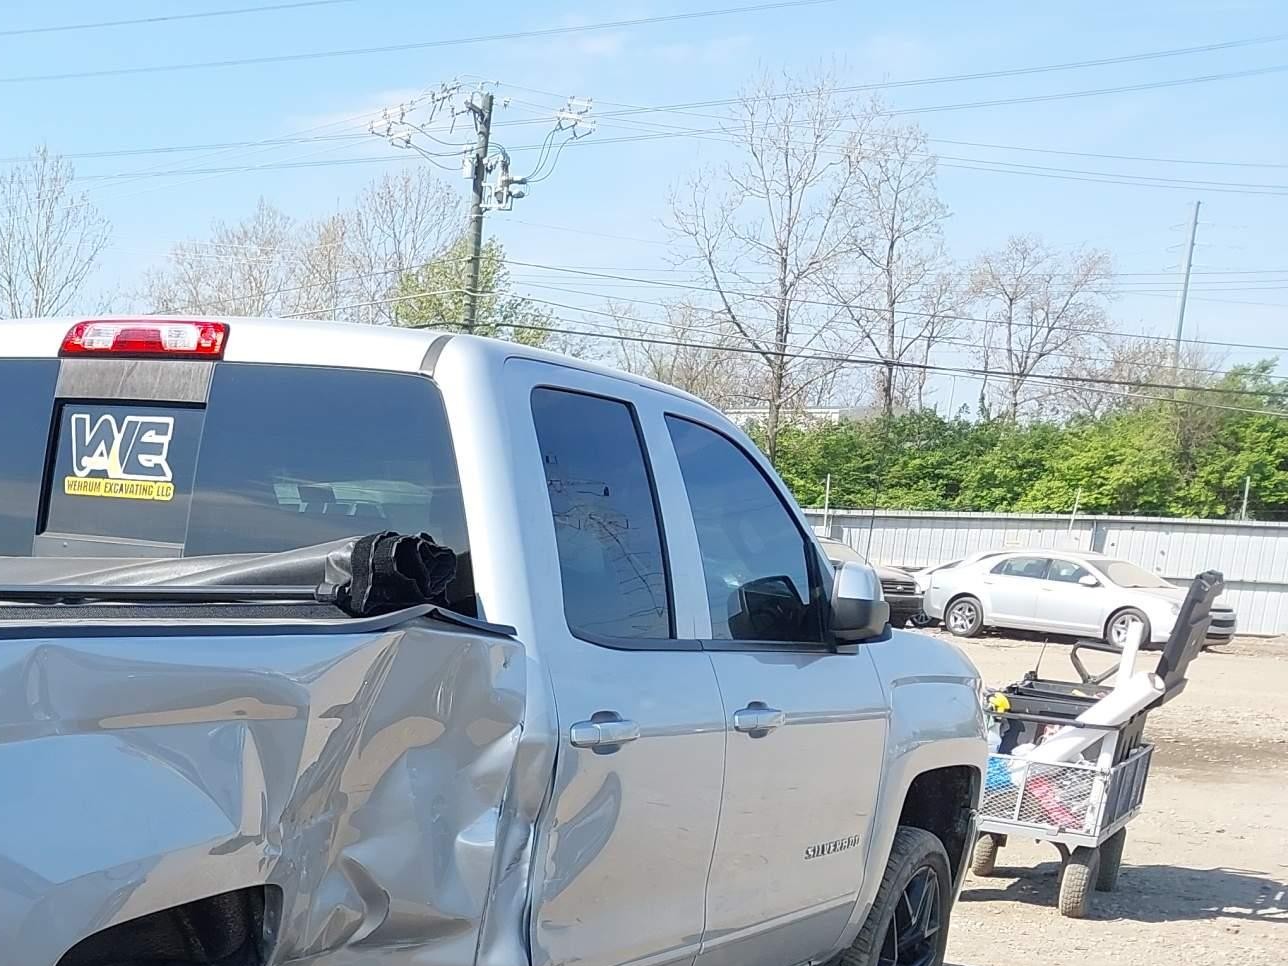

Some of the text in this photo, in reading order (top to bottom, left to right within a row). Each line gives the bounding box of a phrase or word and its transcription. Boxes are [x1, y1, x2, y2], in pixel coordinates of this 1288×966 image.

[71, 414, 174, 481] WE
[67, 479, 172, 498] WEHRUM EXCAVATING LLC
[804, 834, 861, 860] SILVERADO
